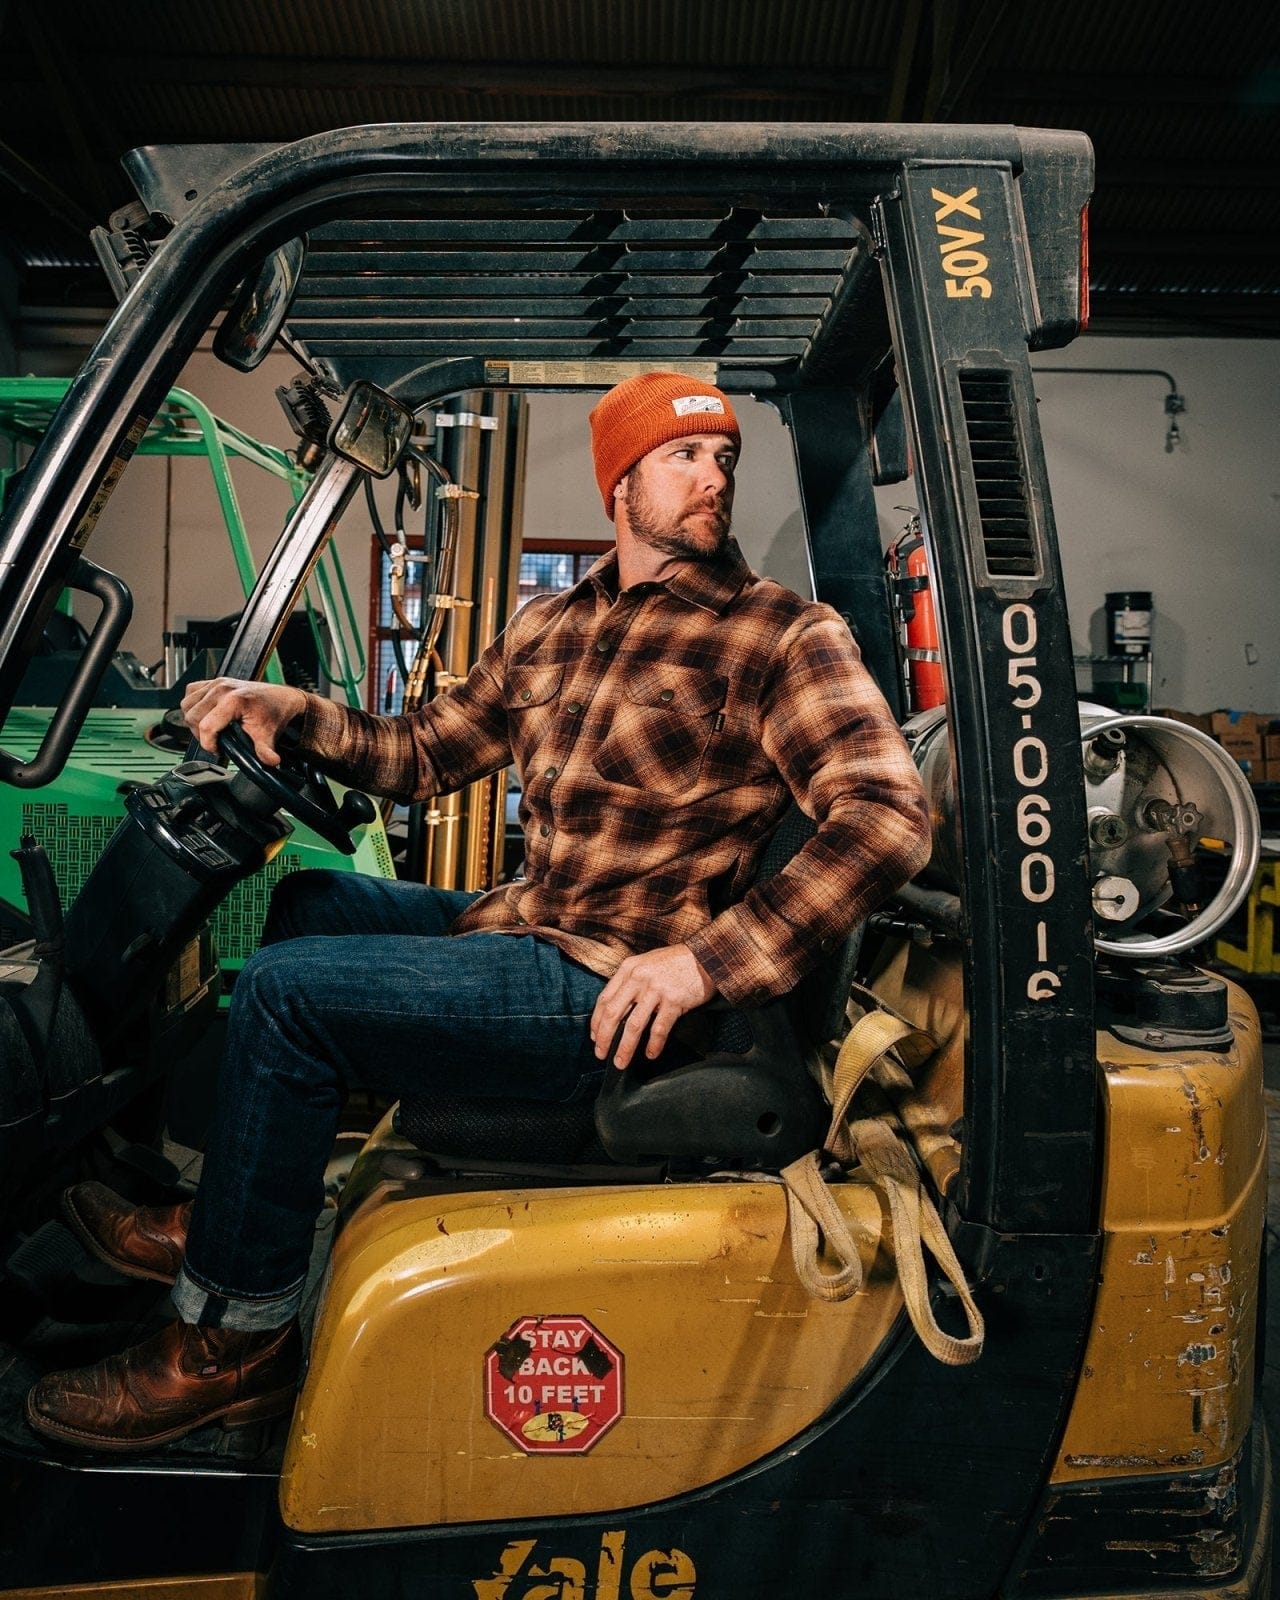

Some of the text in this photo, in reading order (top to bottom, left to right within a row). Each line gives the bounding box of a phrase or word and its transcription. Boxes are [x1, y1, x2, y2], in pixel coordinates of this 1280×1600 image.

[931, 187, 992, 298] 50VX
[520, 1330, 586, 1348] STAY
[518, 1358, 590, 1376] BACK
[504, 1386, 606, 1404] 10 FEET
